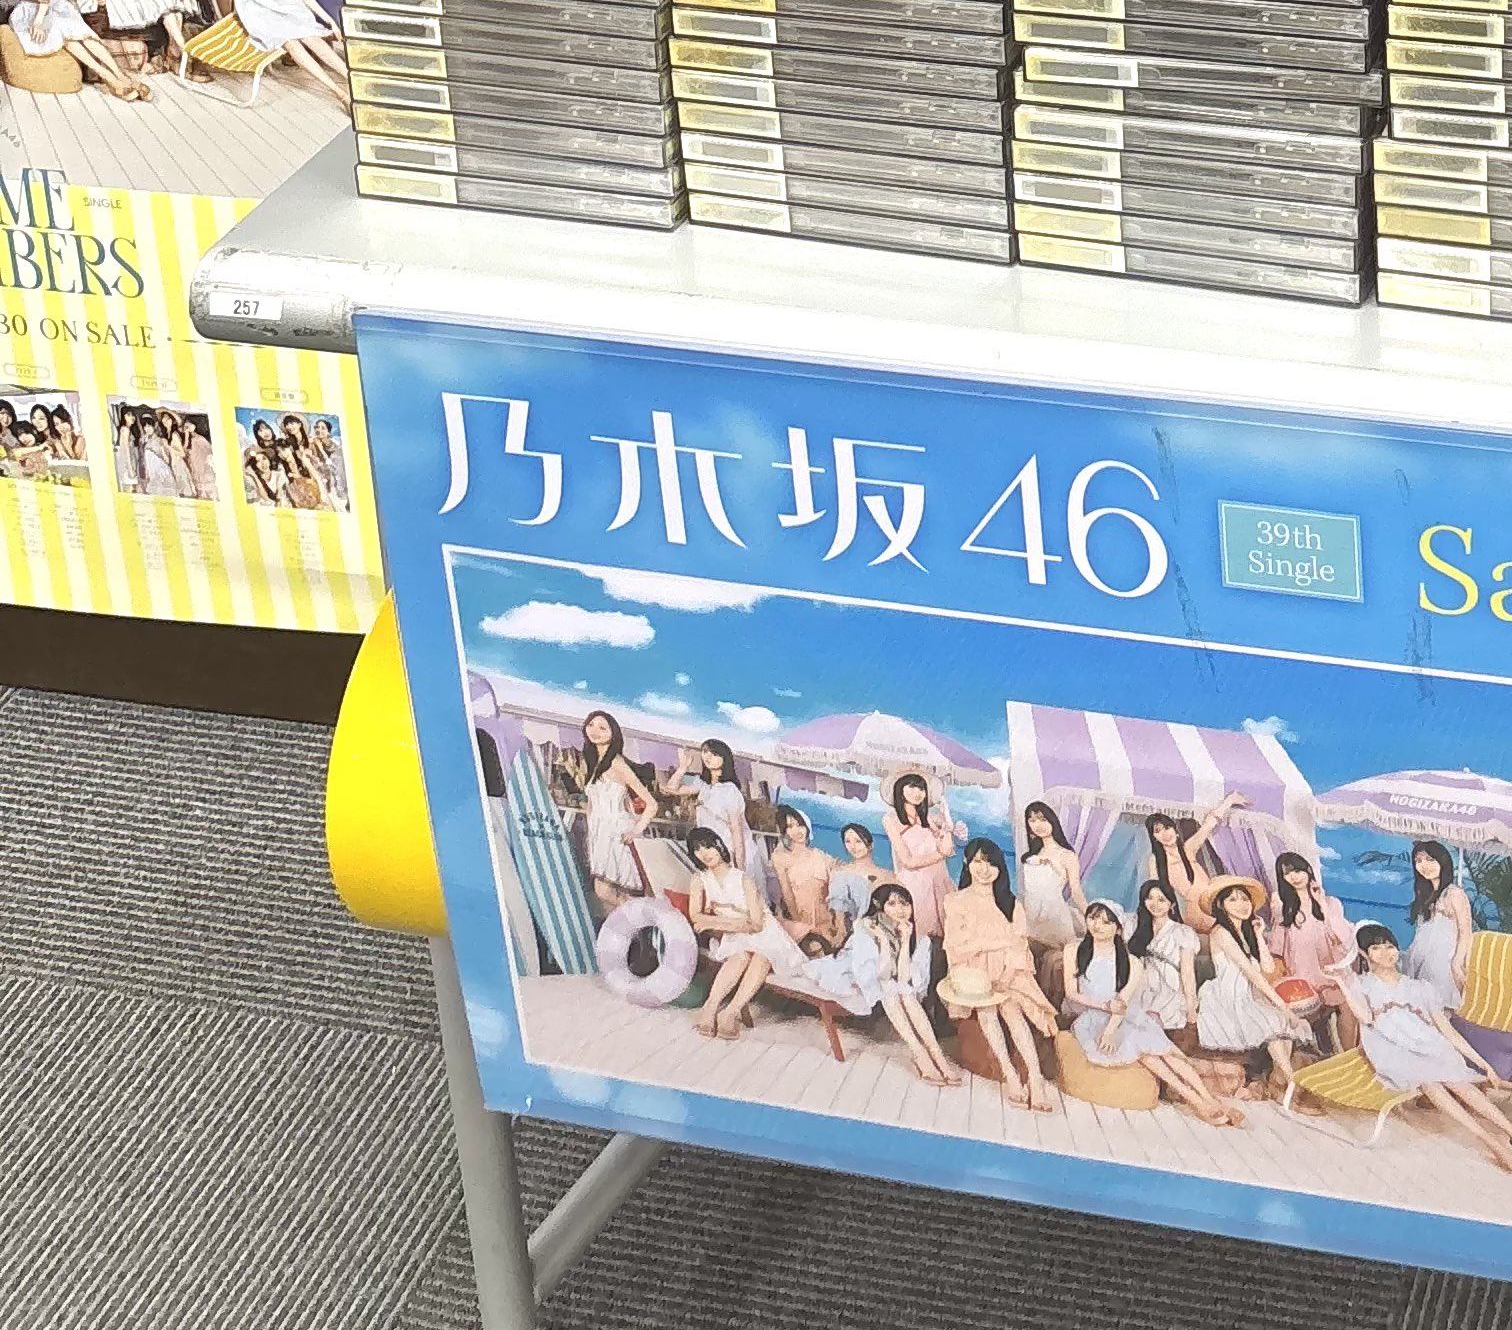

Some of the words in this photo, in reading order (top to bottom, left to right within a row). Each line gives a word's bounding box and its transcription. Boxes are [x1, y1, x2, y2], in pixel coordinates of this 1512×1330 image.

[233, 298, 261, 317] 257
[39, 316, 79, 343] ON
[86, 321, 157, 349] SALE
[438, 391, 1170, 599] 乃木坂46
[1255, 519, 1324, 552] 39th
[1247, 547, 1336, 585] Single
